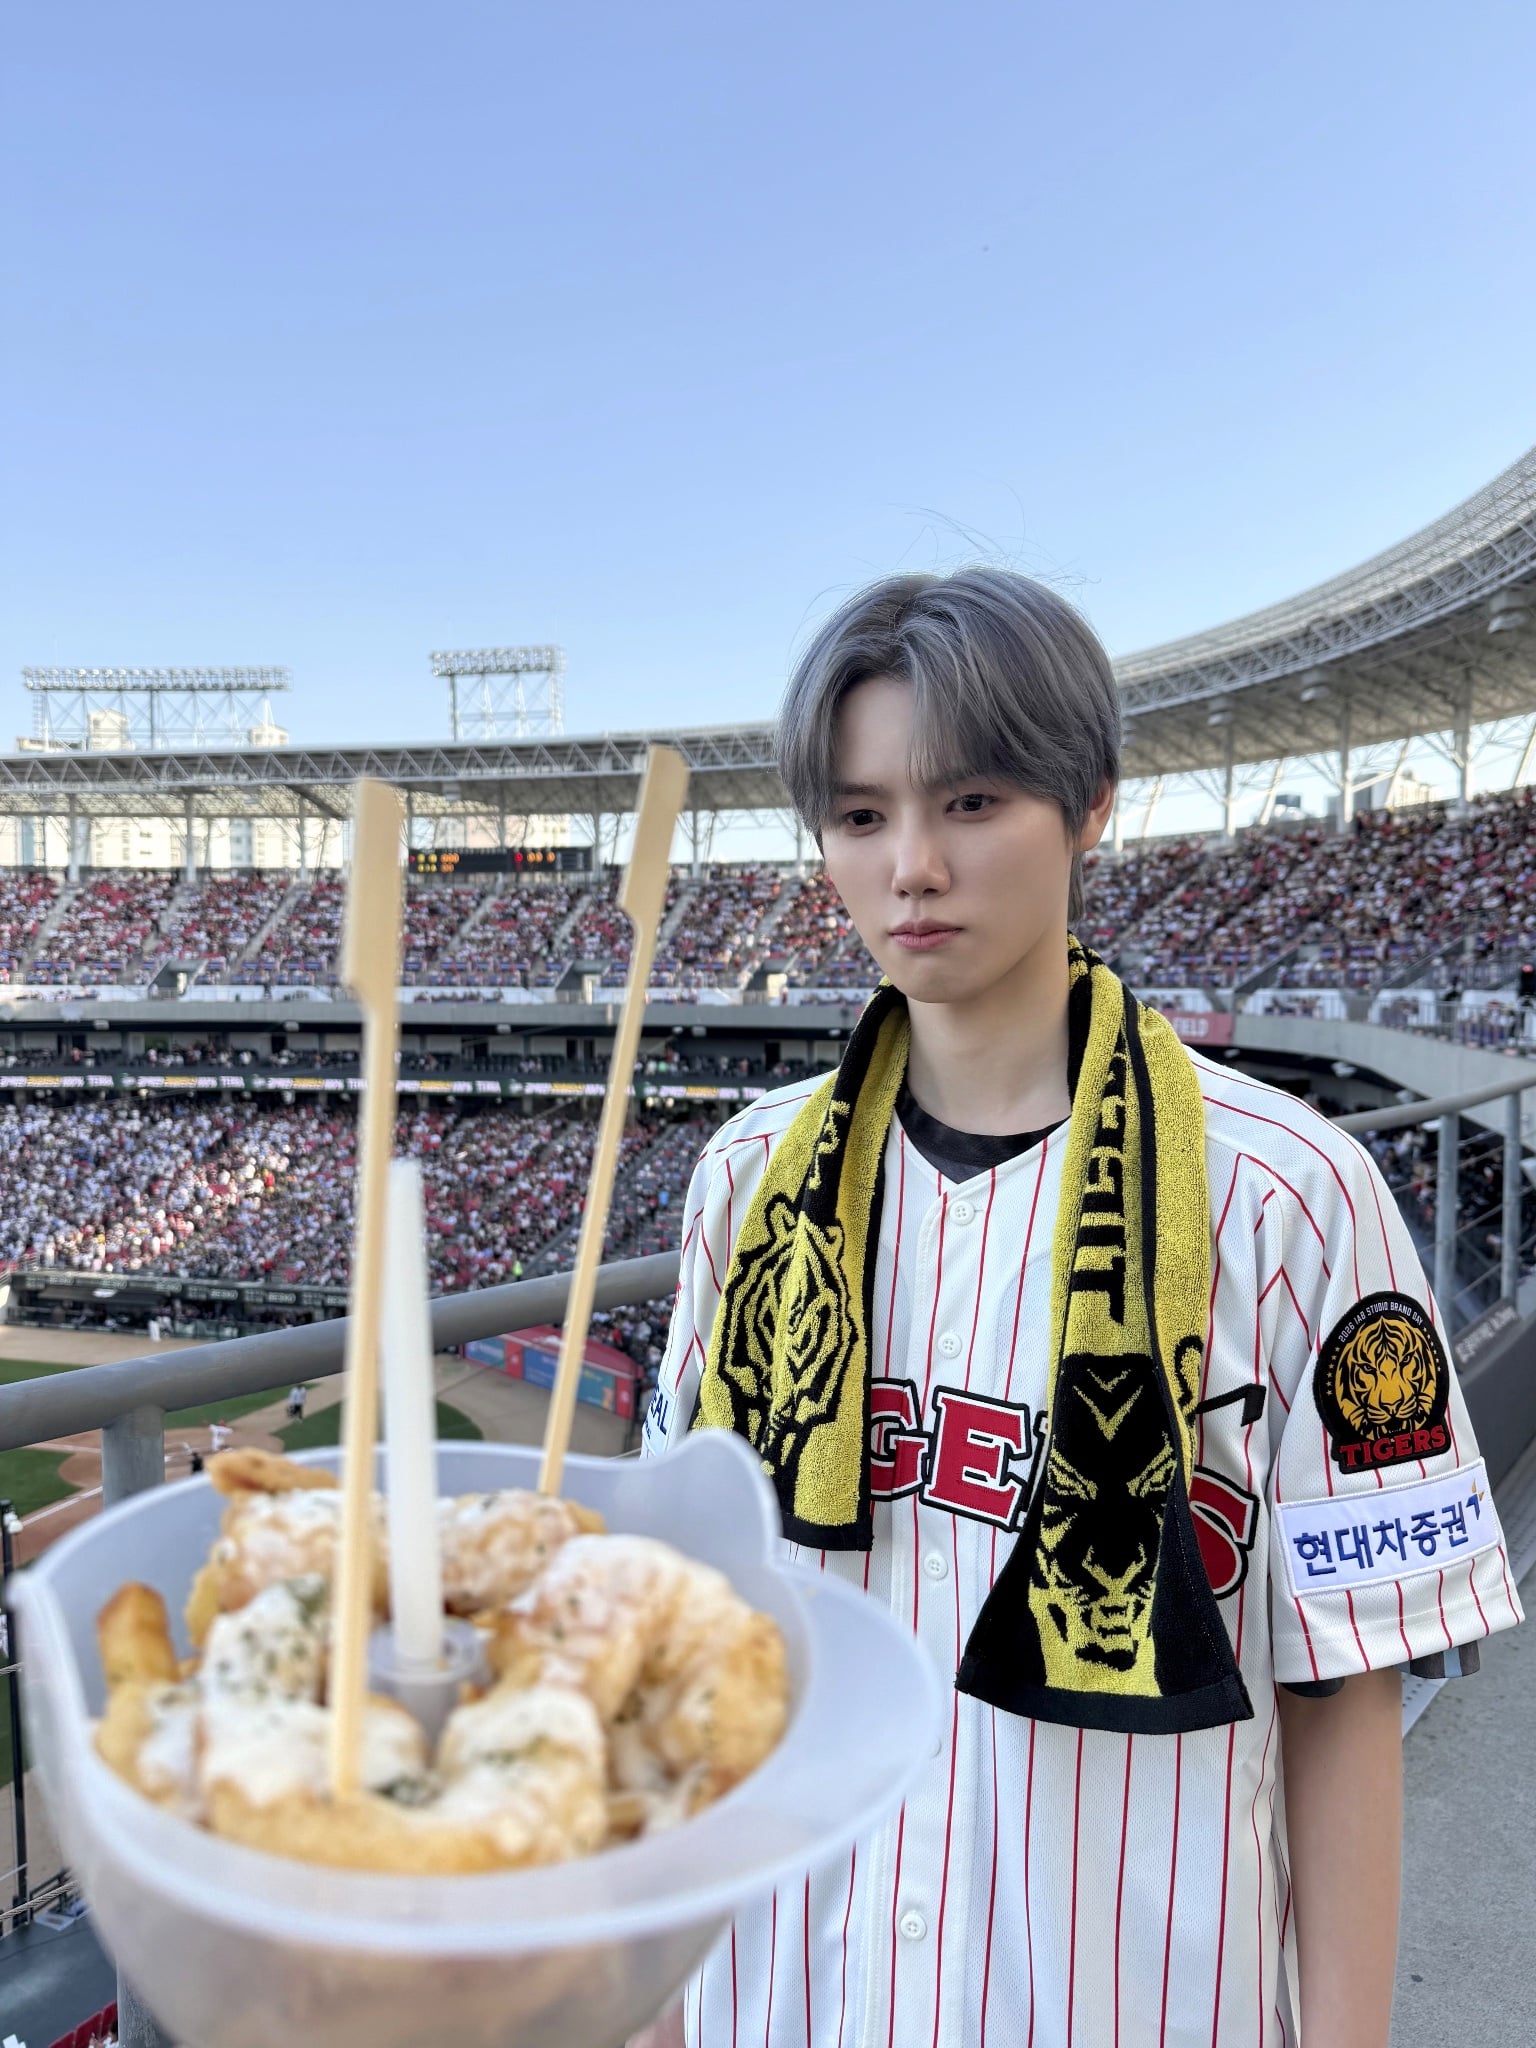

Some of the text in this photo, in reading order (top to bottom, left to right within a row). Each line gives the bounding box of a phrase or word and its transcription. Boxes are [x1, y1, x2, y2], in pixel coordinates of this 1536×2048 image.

[1338, 1322, 1355, 1343] 2026
[1365, 1301, 1389, 1316] STUDIO
[1390, 1301, 1412, 1317] BRAND
[1411, 1311, 1424, 1326] DAY
[1340, 1424, 1446, 1467] TIGERS
[1293, 1501, 1469, 1577] 현대차증권
